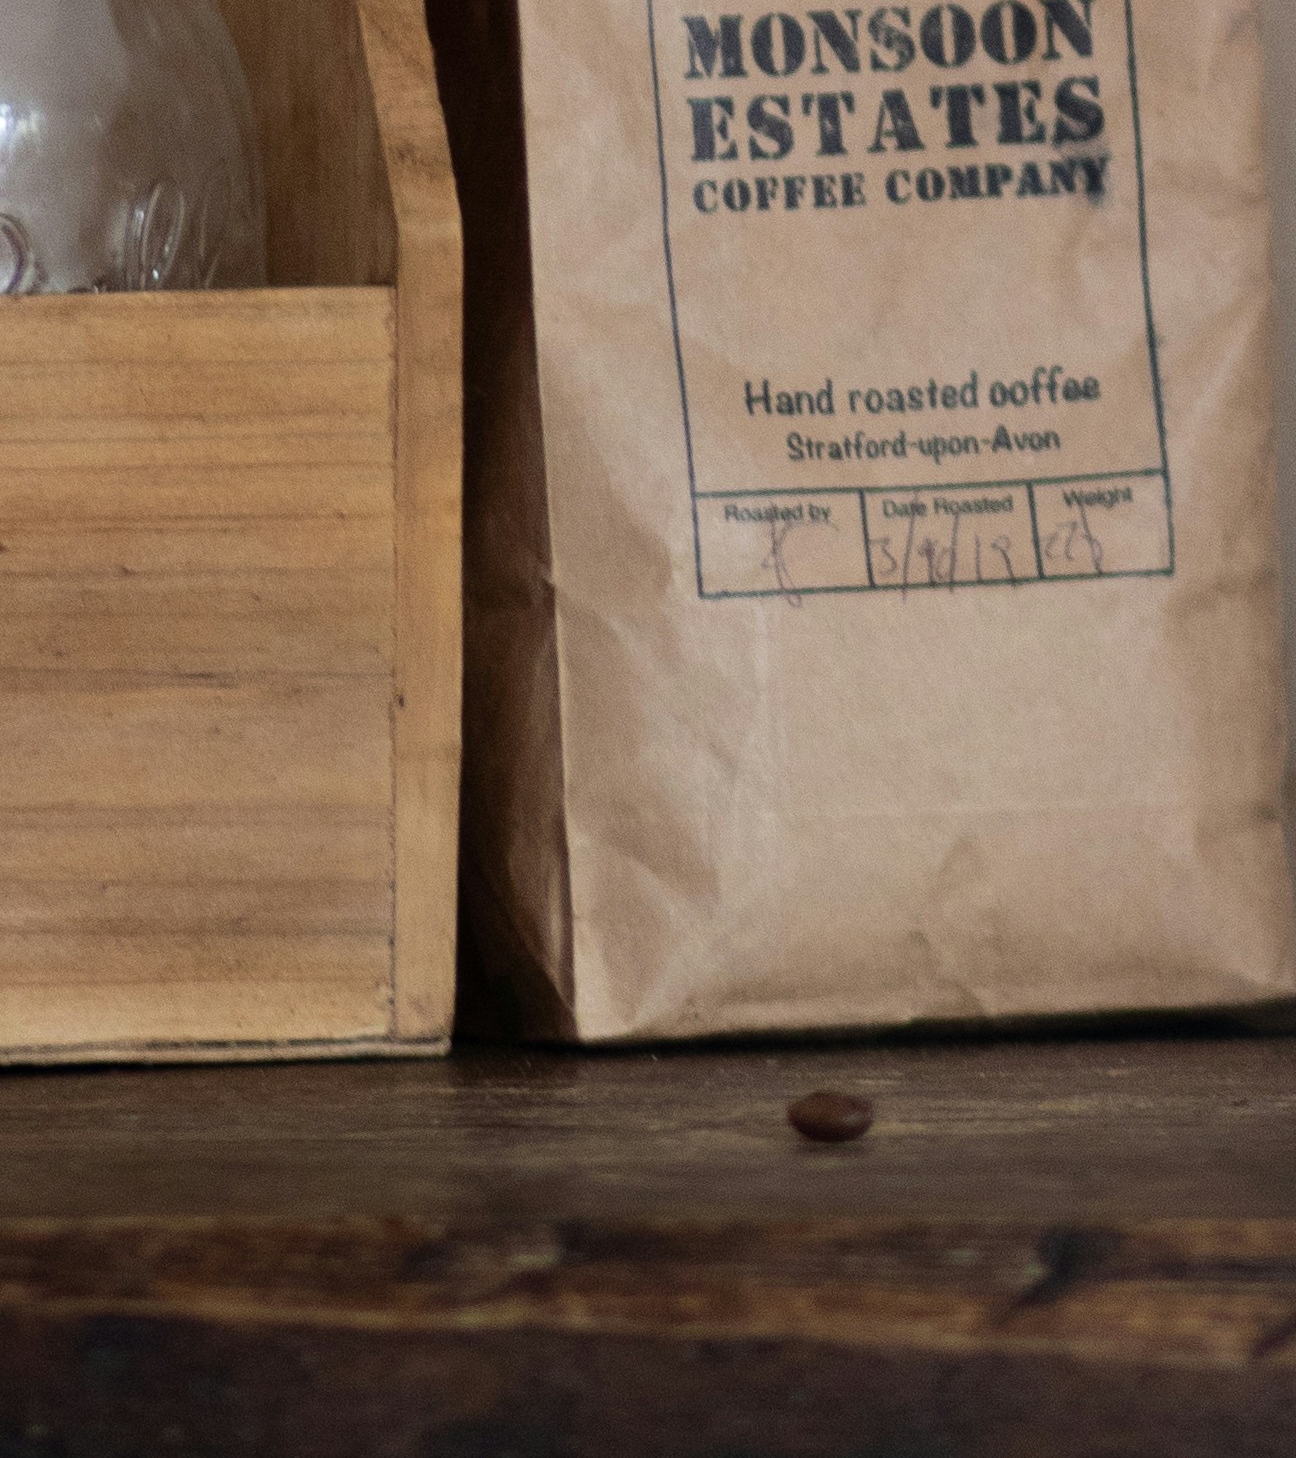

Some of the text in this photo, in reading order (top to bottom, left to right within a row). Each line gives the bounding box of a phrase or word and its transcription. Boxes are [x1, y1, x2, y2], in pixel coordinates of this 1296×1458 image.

[689, 74, 1106, 163] ESTATES
[692, 155, 1110, 215] COFFEE COMPANY
[744, 364, 1102, 418] Hand roasted coffee
[786, 423, 1062, 468] Stratford-upon-Avon
[882, 494, 1014, 519] Date Roasted
